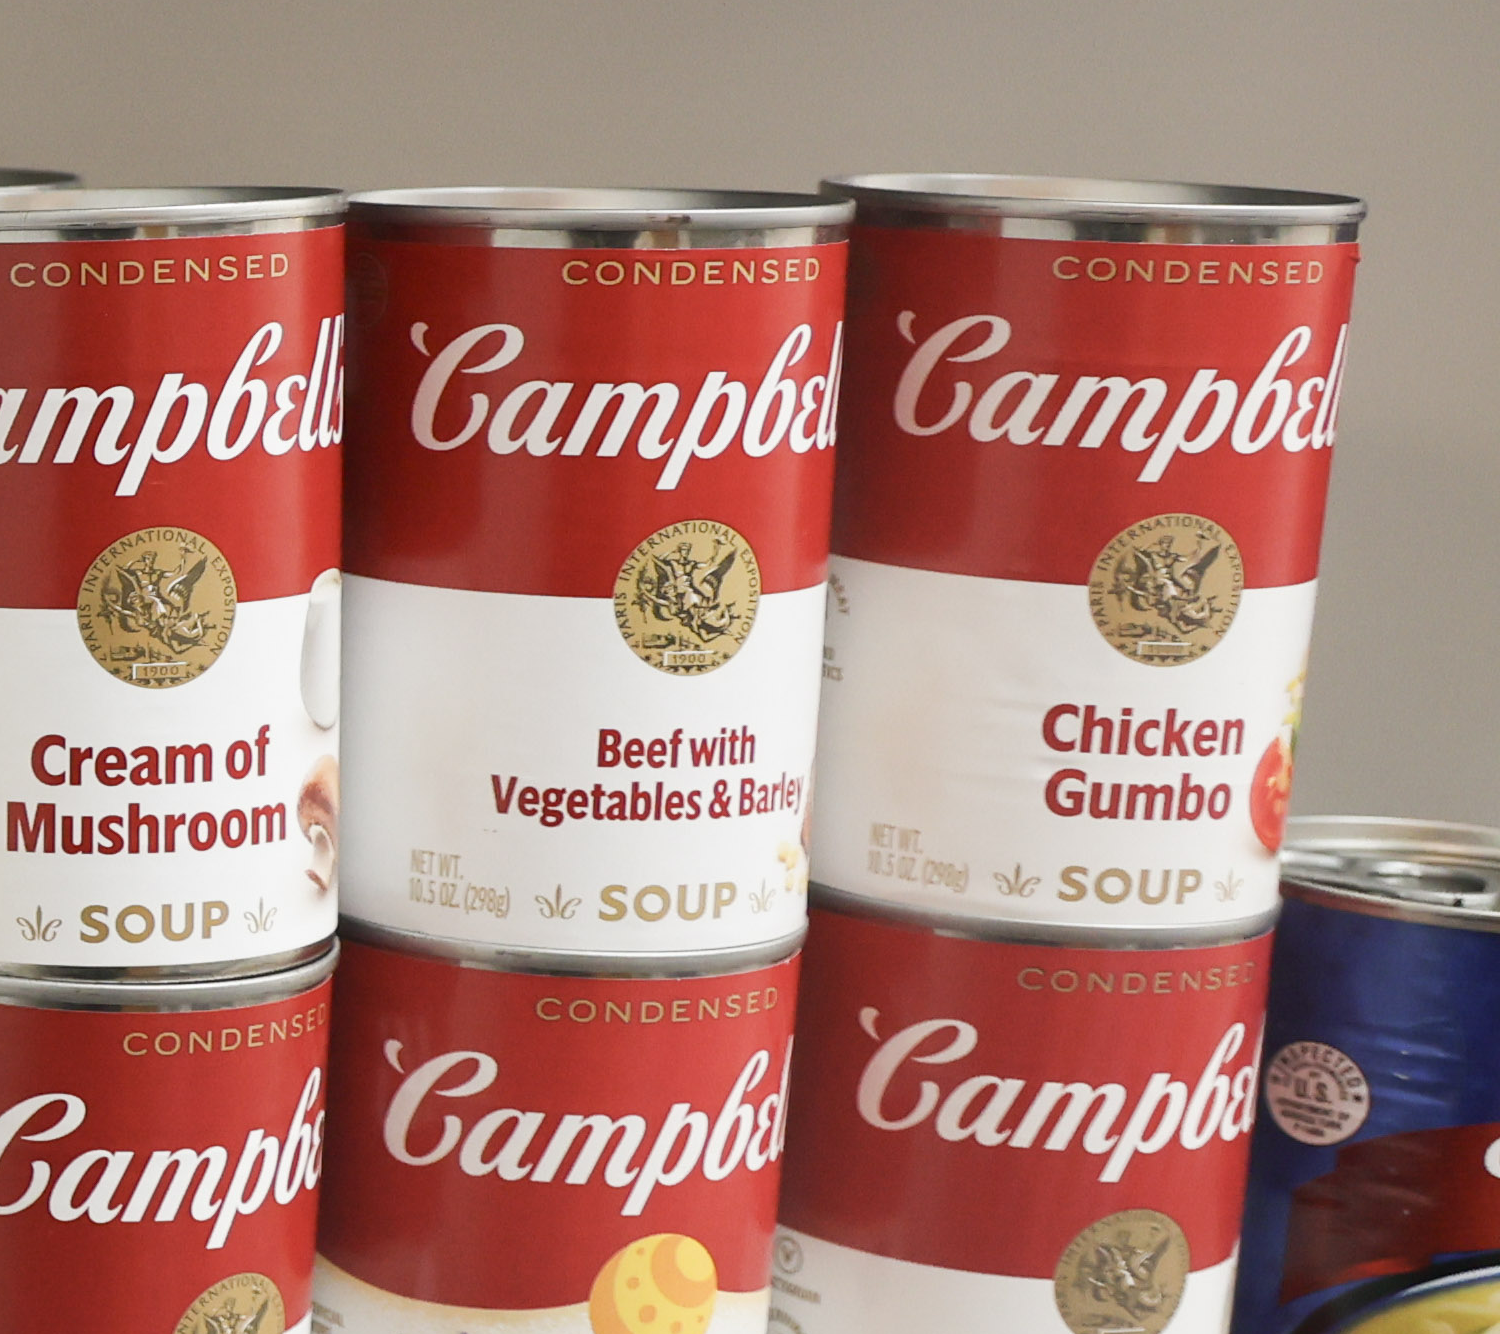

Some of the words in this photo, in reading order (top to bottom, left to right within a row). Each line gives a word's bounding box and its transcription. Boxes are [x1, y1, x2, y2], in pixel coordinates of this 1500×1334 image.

[9, 252, 289, 289] CONDENSED
[561, 258, 821, 286] CONDENSED
[1052, 255, 1323, 286] CONDENSED
[408, 320, 844, 492] Campbell
[894, 310, 1348, 483] Campbell
[83, 529, 206, 592] INTERNATIONAL
[79, 603, 102, 653] PARIS
[210, 556, 234, 656] EXPOSITION
[143, 667, 179, 676] 1900
[597, 728, 683, 769] Beef
[690, 725, 756, 767] with
[1041, 703, 1245, 757] Chicken
[30, 732, 213, 788] Cream
[224, 725, 272, 781] of
[491, 774, 702, 828] Vegetables
[708, 779, 732, 819] &
[739, 771, 804, 817] Barley
[1043, 767, 1231, 822] Gumbo
[5, 798, 288, 859] Mushroom
[599, 881, 737, 922] SOUP
[1058, 865, 1203, 905] SOUP
[79, 900, 229, 944] SOUP
[1017, 960, 1258, 996] CONDENSED
[122, 1002, 330, 1058] CONDENSED
[536, 986, 780, 1025] CONDENSED
